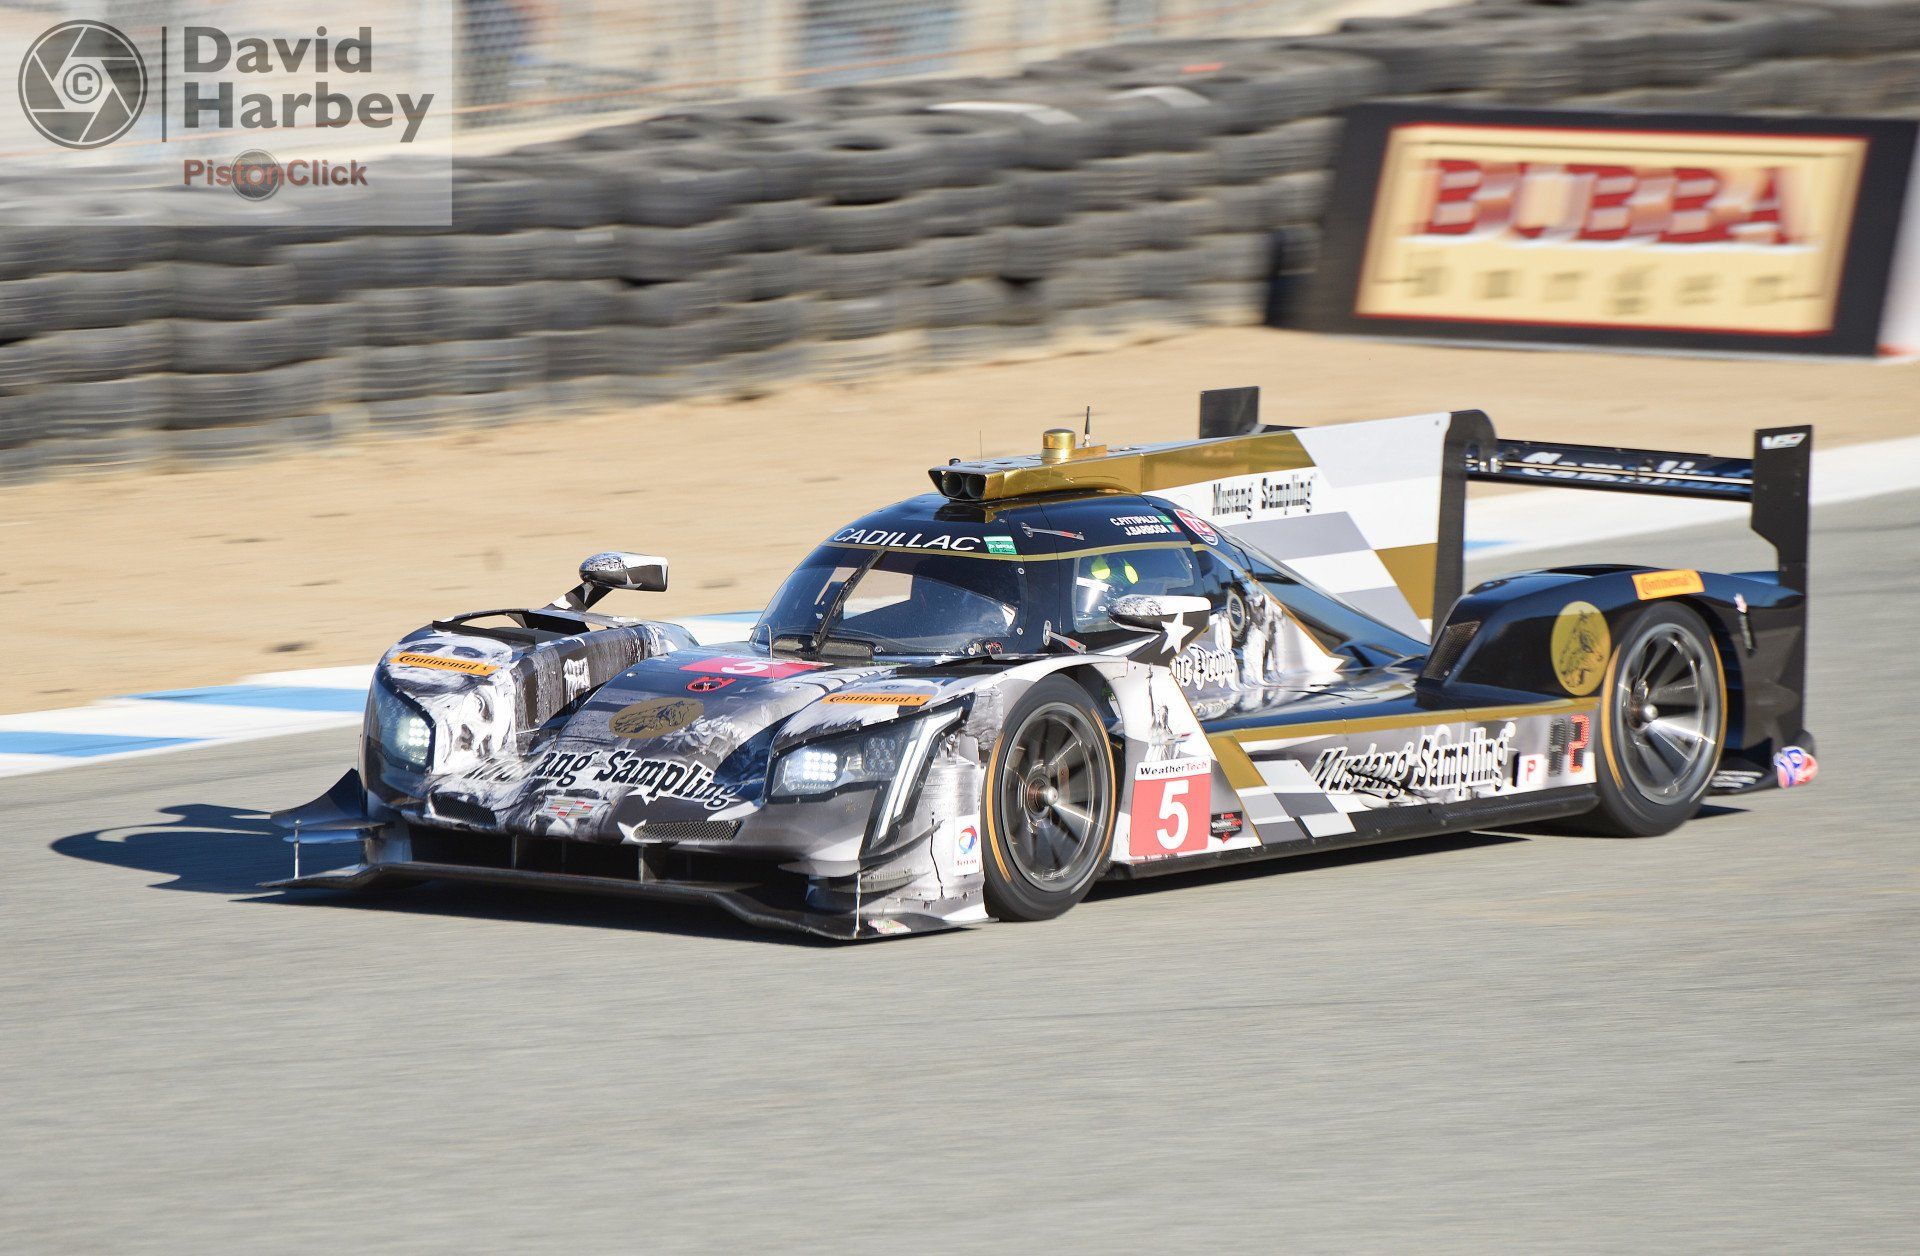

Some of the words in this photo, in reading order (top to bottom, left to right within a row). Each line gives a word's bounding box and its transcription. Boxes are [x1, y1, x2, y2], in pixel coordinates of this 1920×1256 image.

[1418, 158, 1800, 247] BUBBA
[833, 528, 981, 551] CADILLAC
[399, 654, 477, 671] Continental
[829, 694, 911, 703] Continental
[595, 749, 746, 810] Sampling
[1140, 761, 1208, 776] WeatherTech
[1525, 759, 1537, 782] P
[1156, 779, 1189, 850] 5
